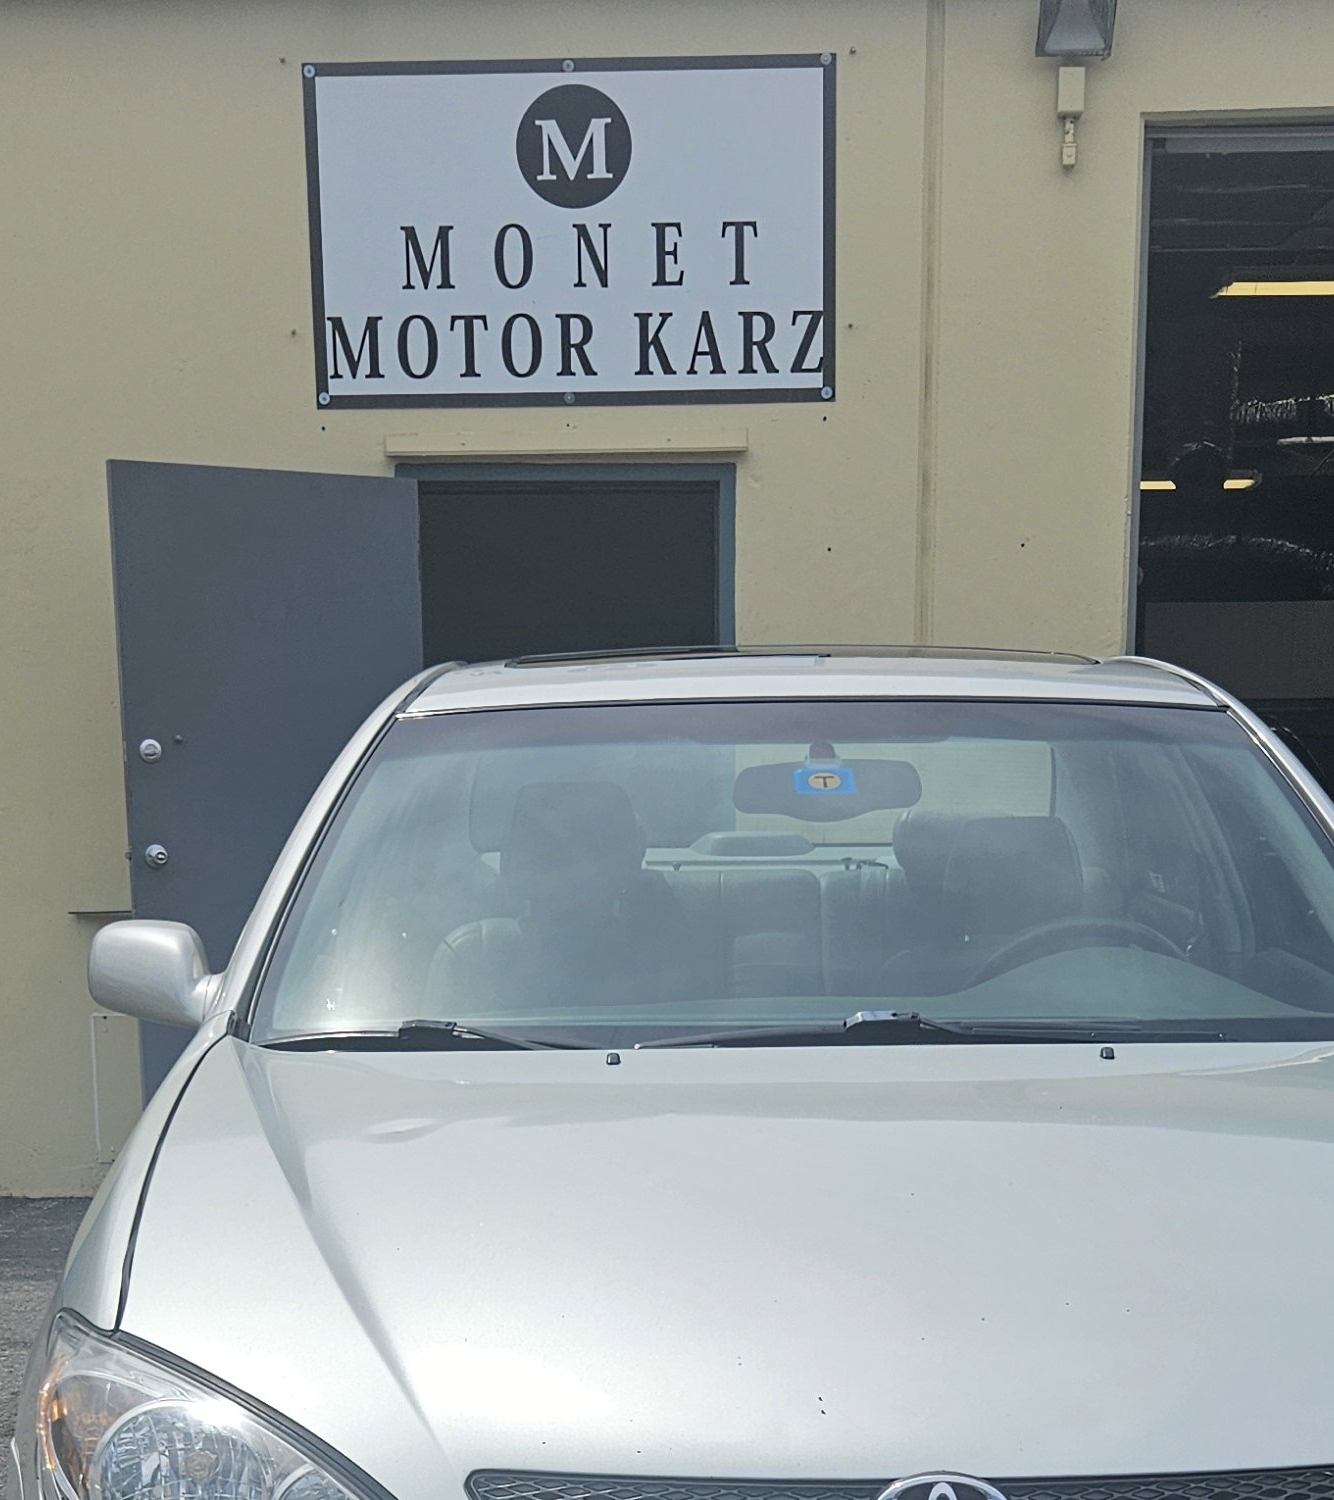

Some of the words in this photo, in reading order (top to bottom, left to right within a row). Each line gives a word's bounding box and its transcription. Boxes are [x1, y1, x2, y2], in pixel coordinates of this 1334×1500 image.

[535, 117, 614, 181] M
[400, 220, 759, 291] MONET
[327, 313, 598, 380] MOTOR
[633, 310, 824, 377] KARZ
